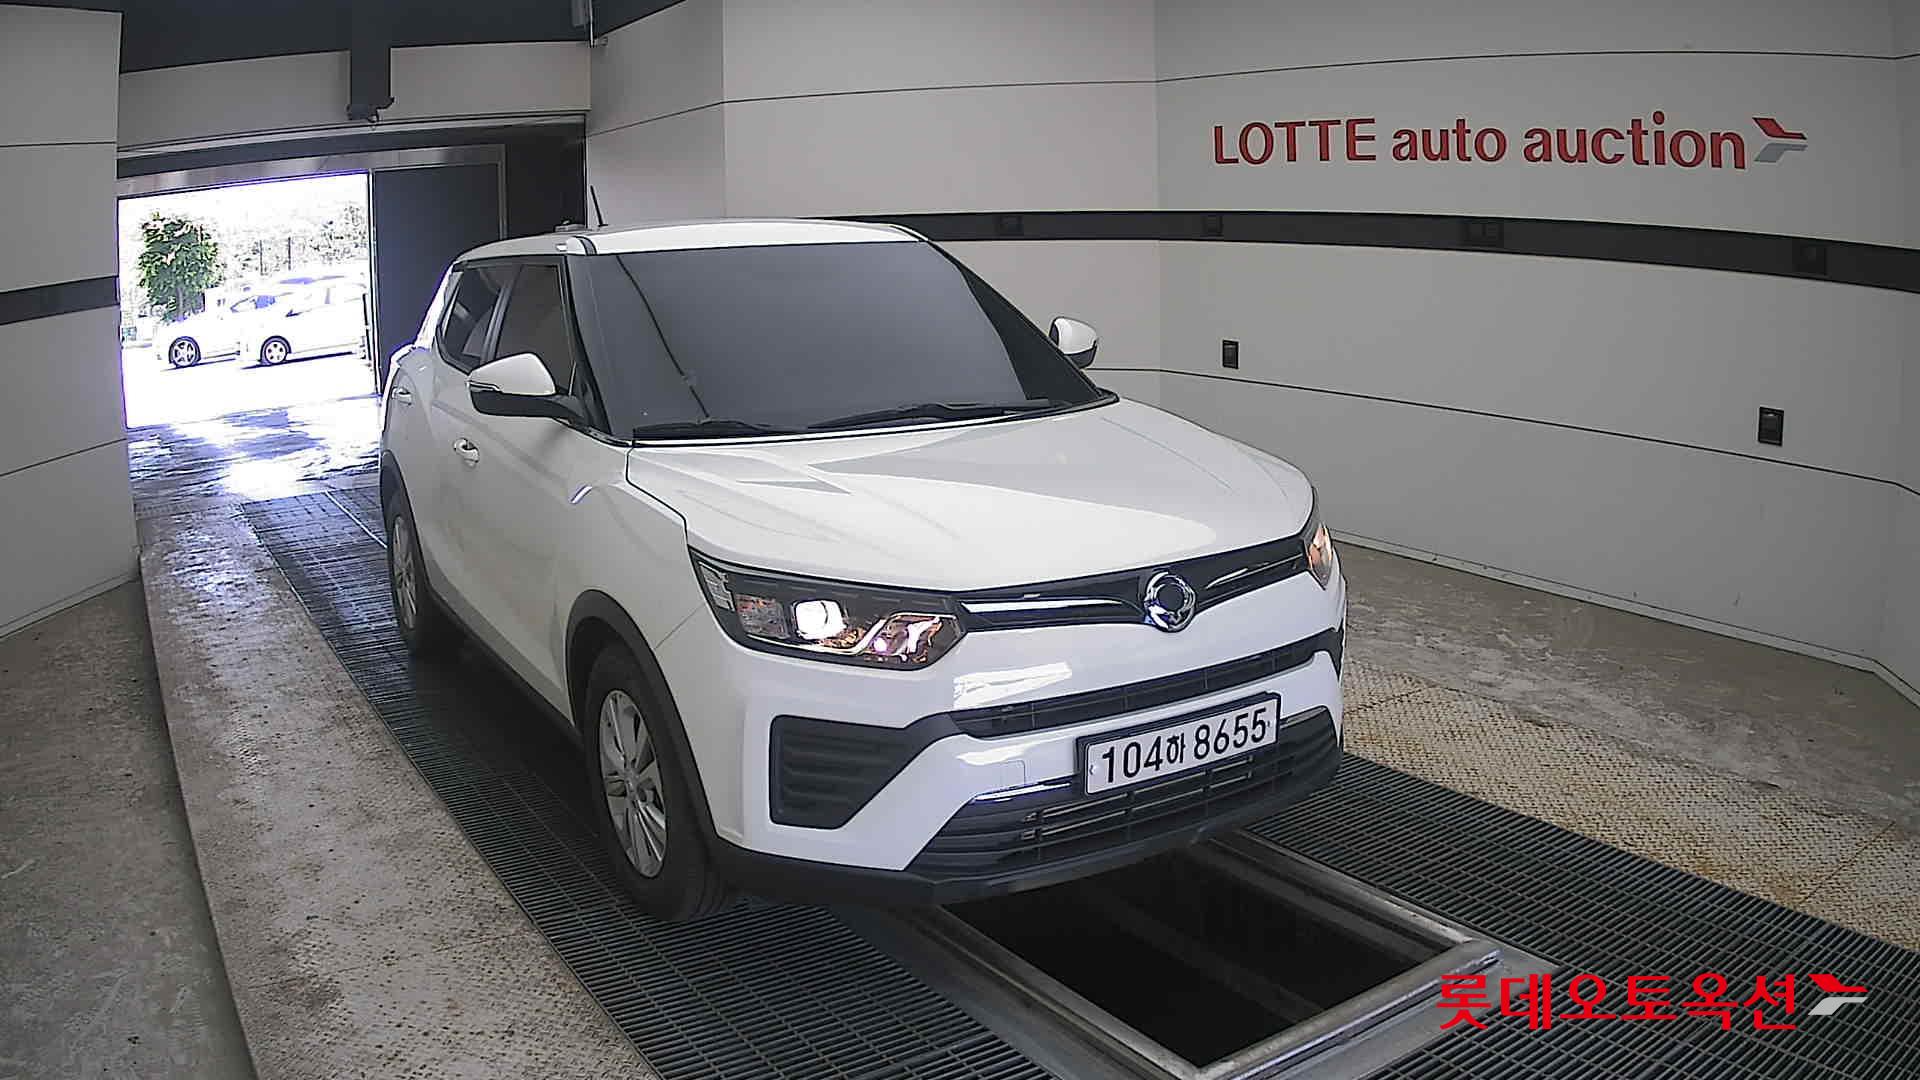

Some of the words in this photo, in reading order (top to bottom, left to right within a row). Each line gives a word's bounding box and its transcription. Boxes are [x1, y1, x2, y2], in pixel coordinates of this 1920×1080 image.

[1213, 117, 1377, 165] LOTTE
[1392, 118, 1508, 163] auto
[1523, 111, 1747, 170] auction
[1102, 732, 1186, 783] 104하
[1194, 707, 1267, 760] 8655
